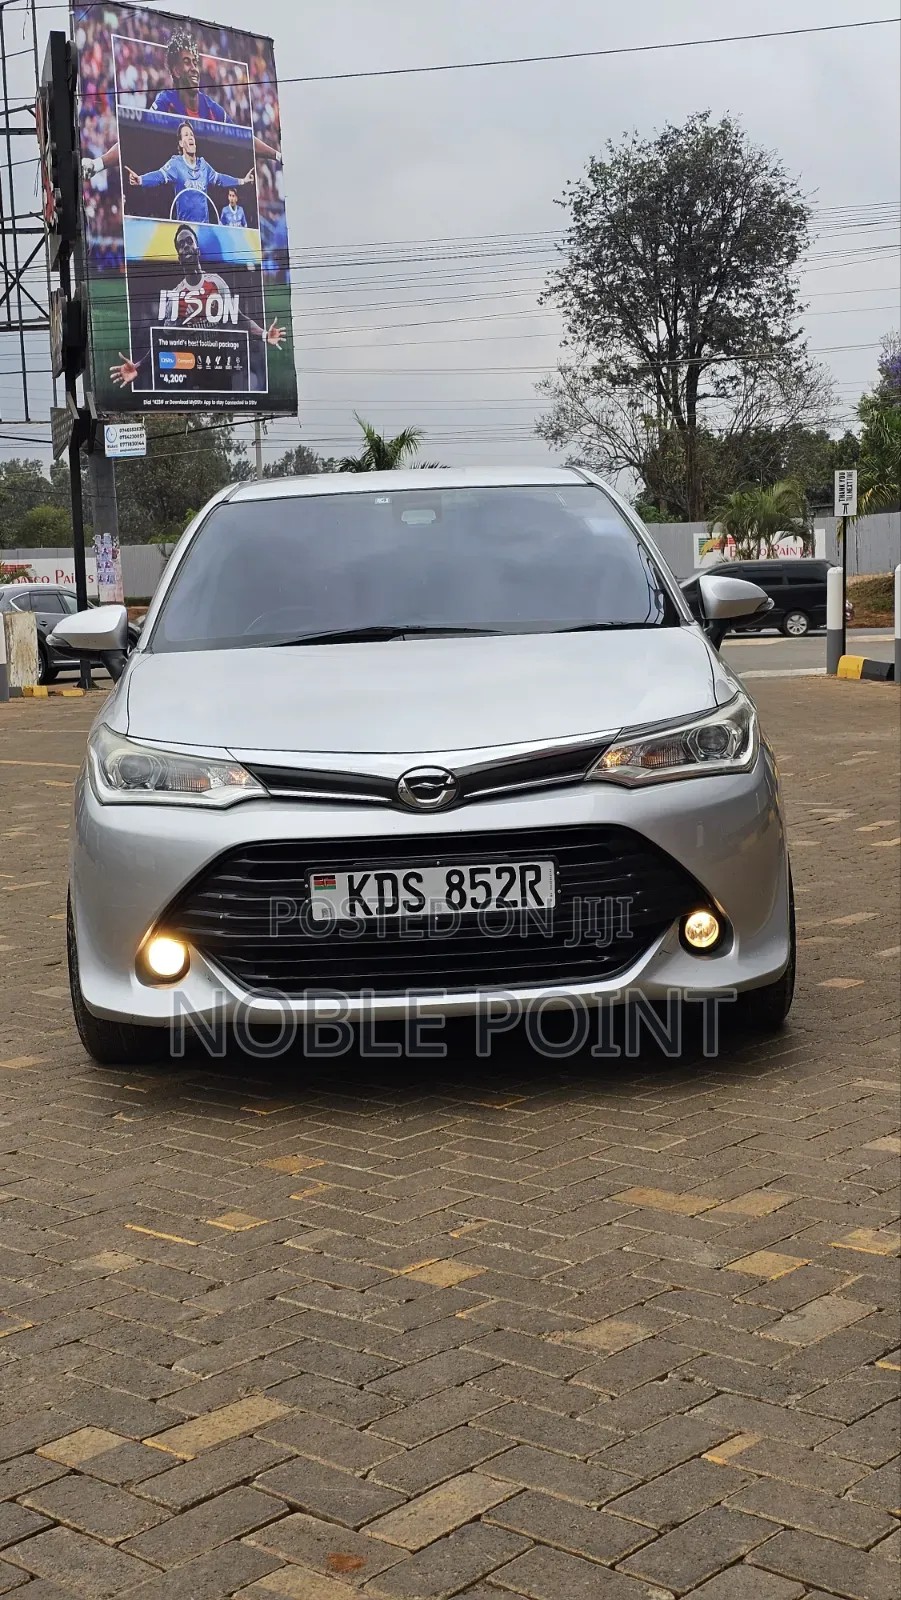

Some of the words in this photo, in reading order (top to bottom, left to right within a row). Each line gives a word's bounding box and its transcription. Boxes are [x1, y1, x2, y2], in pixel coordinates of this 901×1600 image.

[206, 293, 240, 325] ON
[218, 341, 240, 350] package
[347, 871, 426, 917] KDS
[445, 864, 545, 911] 852R
